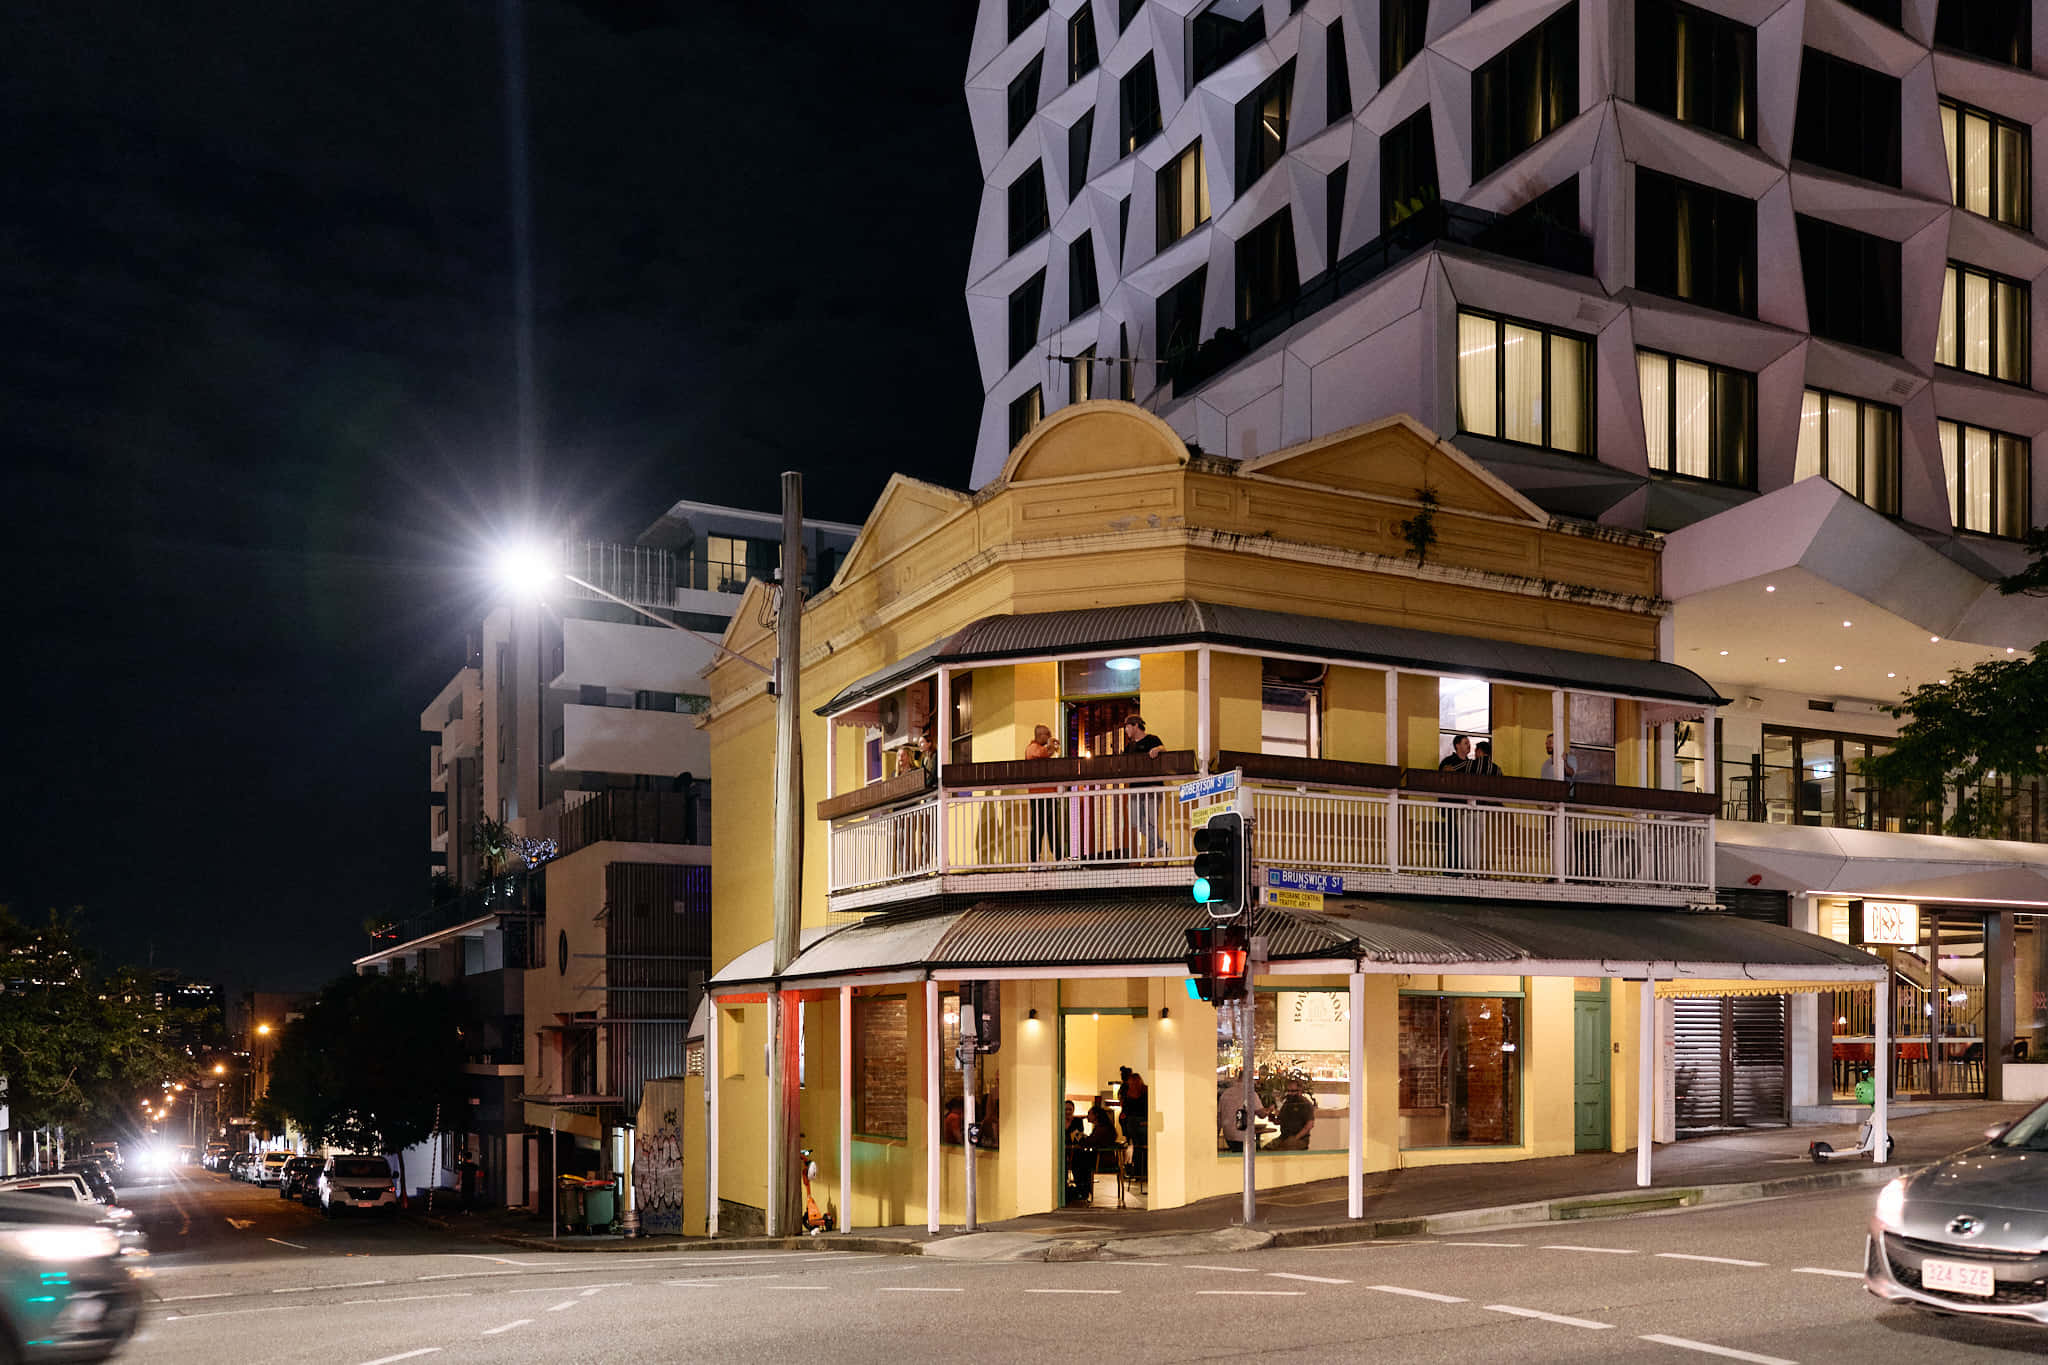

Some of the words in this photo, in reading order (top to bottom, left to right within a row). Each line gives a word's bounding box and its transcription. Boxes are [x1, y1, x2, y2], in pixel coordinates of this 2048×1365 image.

[1181, 777, 1214, 794] ROBERTSON
[1216, 775, 1224, 788] ST
[1282, 871, 1328, 886] BRUNSWICK
[1331, 876, 1340, 888] ST
